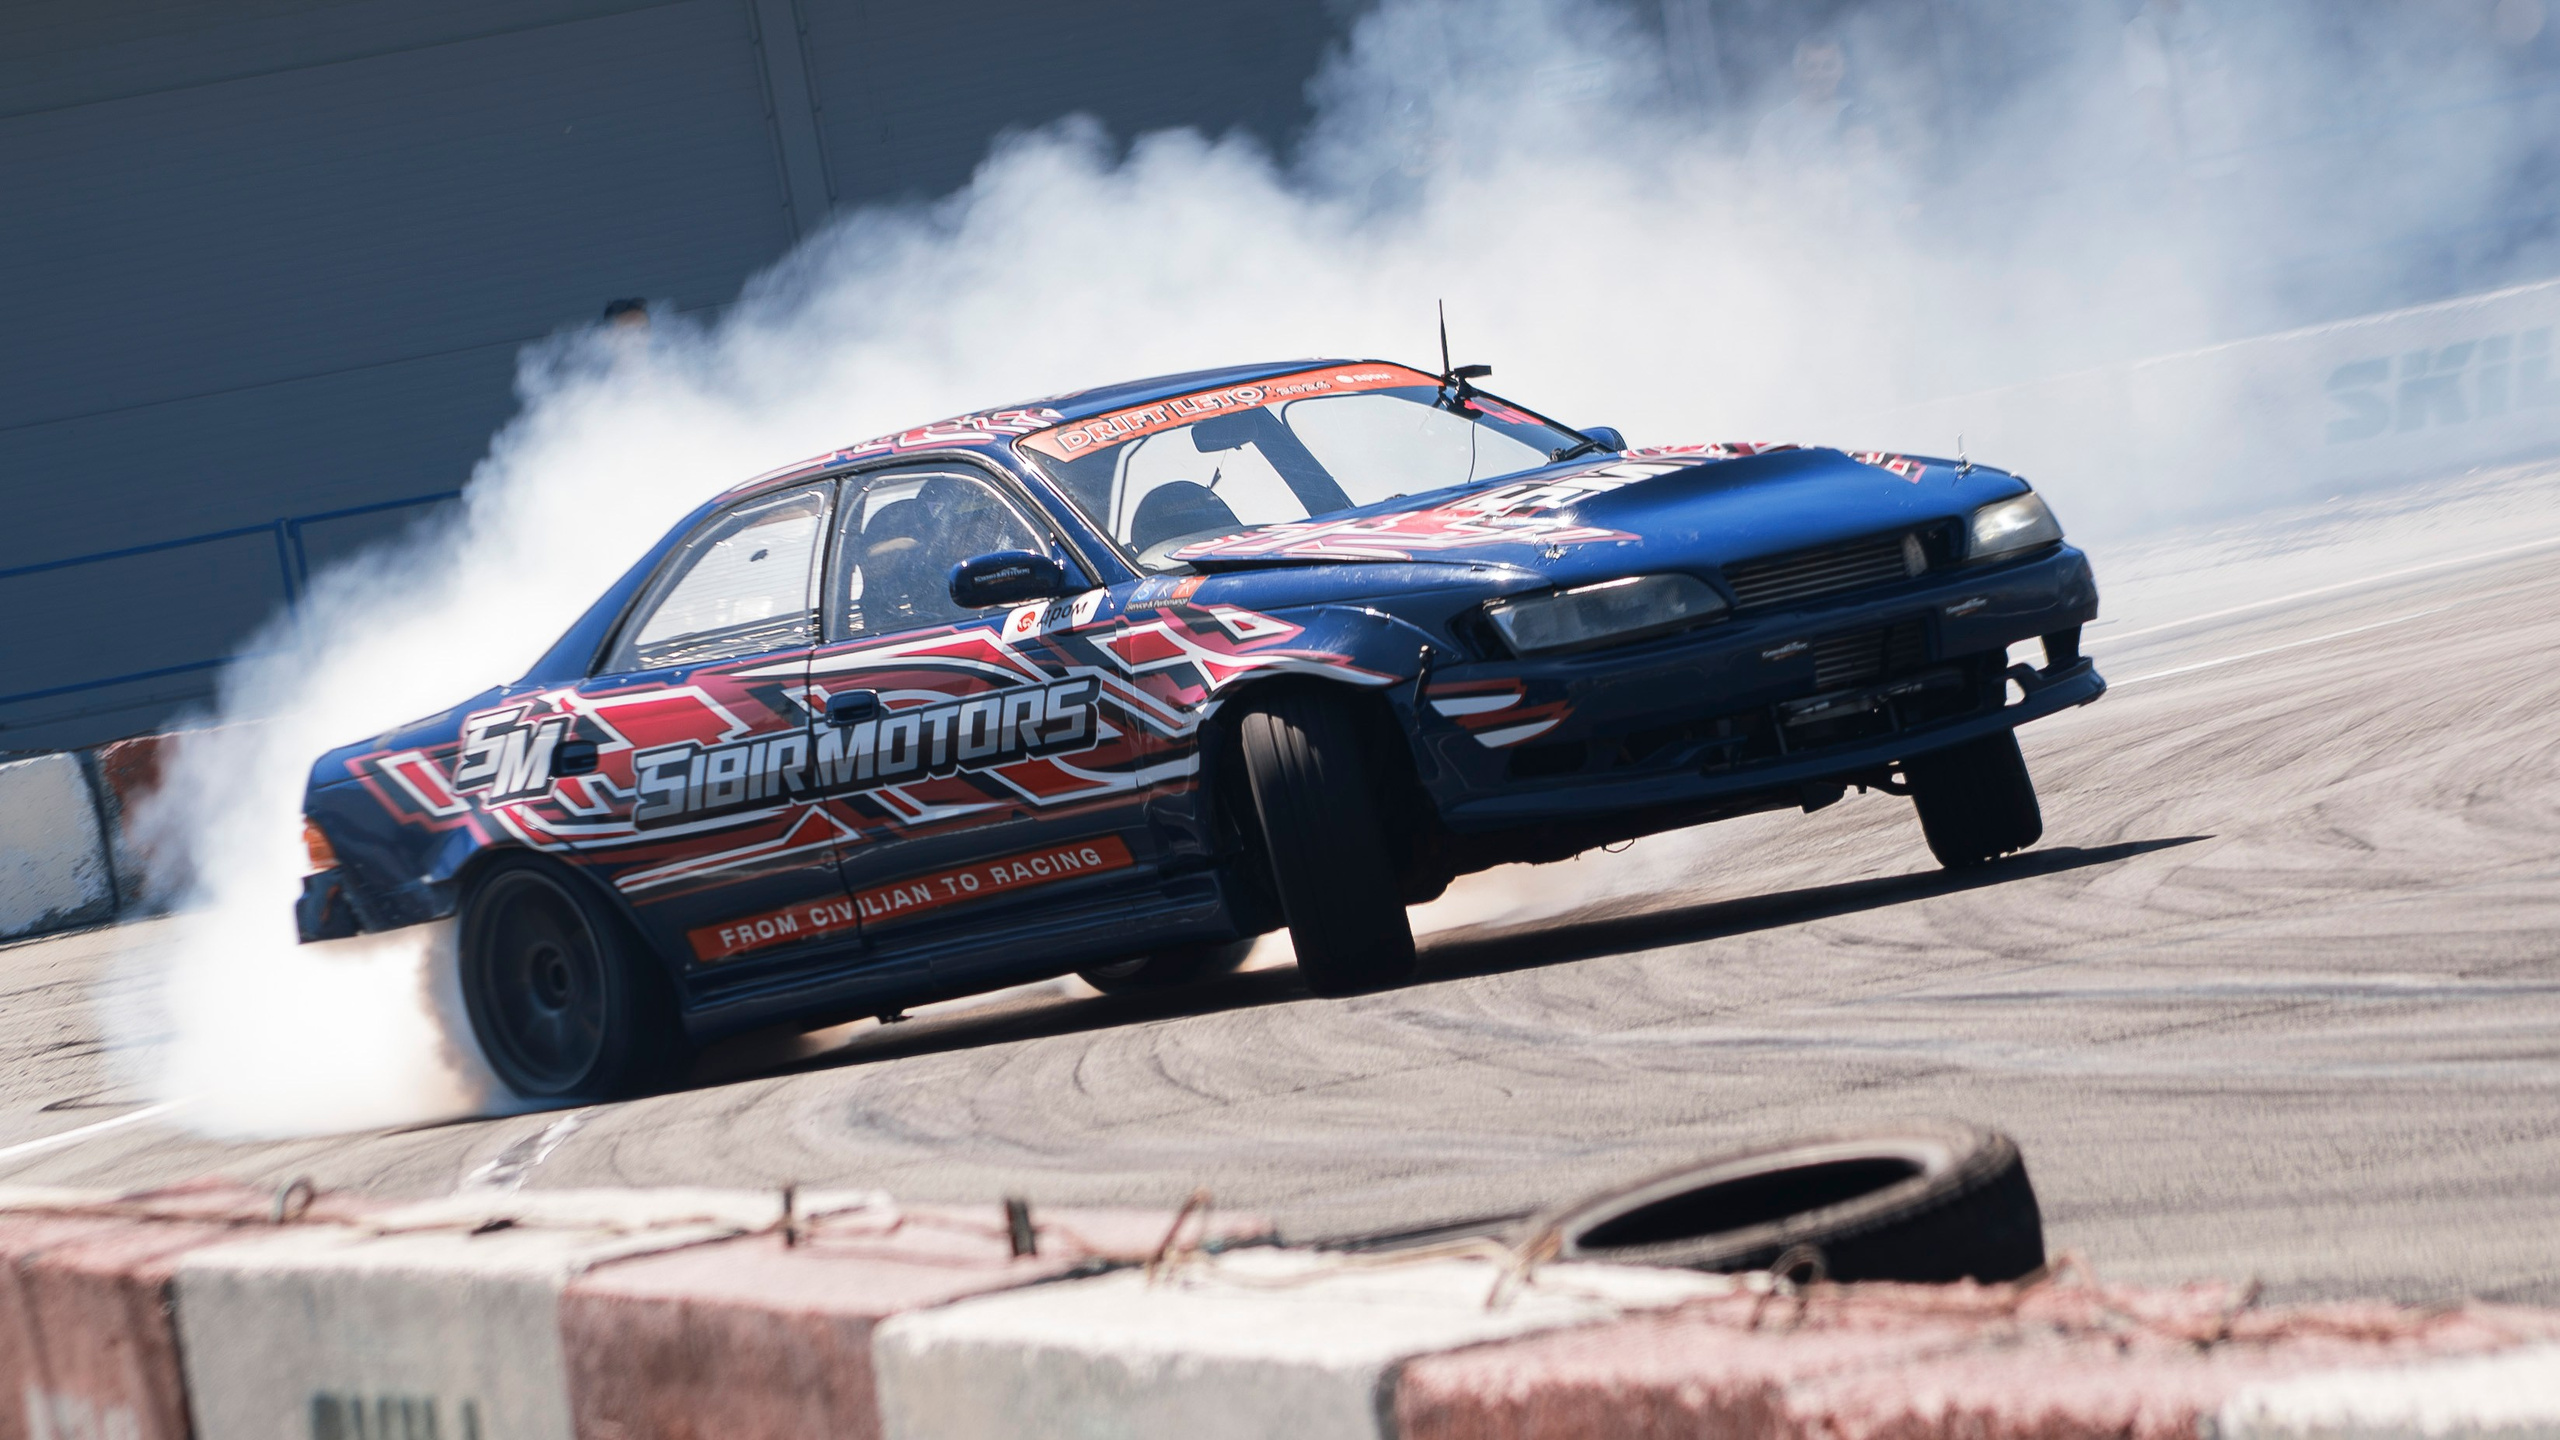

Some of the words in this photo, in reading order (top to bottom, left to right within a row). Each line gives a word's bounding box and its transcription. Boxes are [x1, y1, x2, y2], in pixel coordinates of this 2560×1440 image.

[1056, 404, 1169, 452] DRIFT
[1168, 386, 1265, 417] LETO
[455, 702, 564, 800] SM
[636, 733, 808, 822] SIBIR
[814, 680, 1091, 787] MOTORS
[719, 913, 799, 949] FROM
[810, 884, 932, 927] CIVILIAN
[940, 873, 980, 896] TO
[994, 847, 1102, 886] RACING
